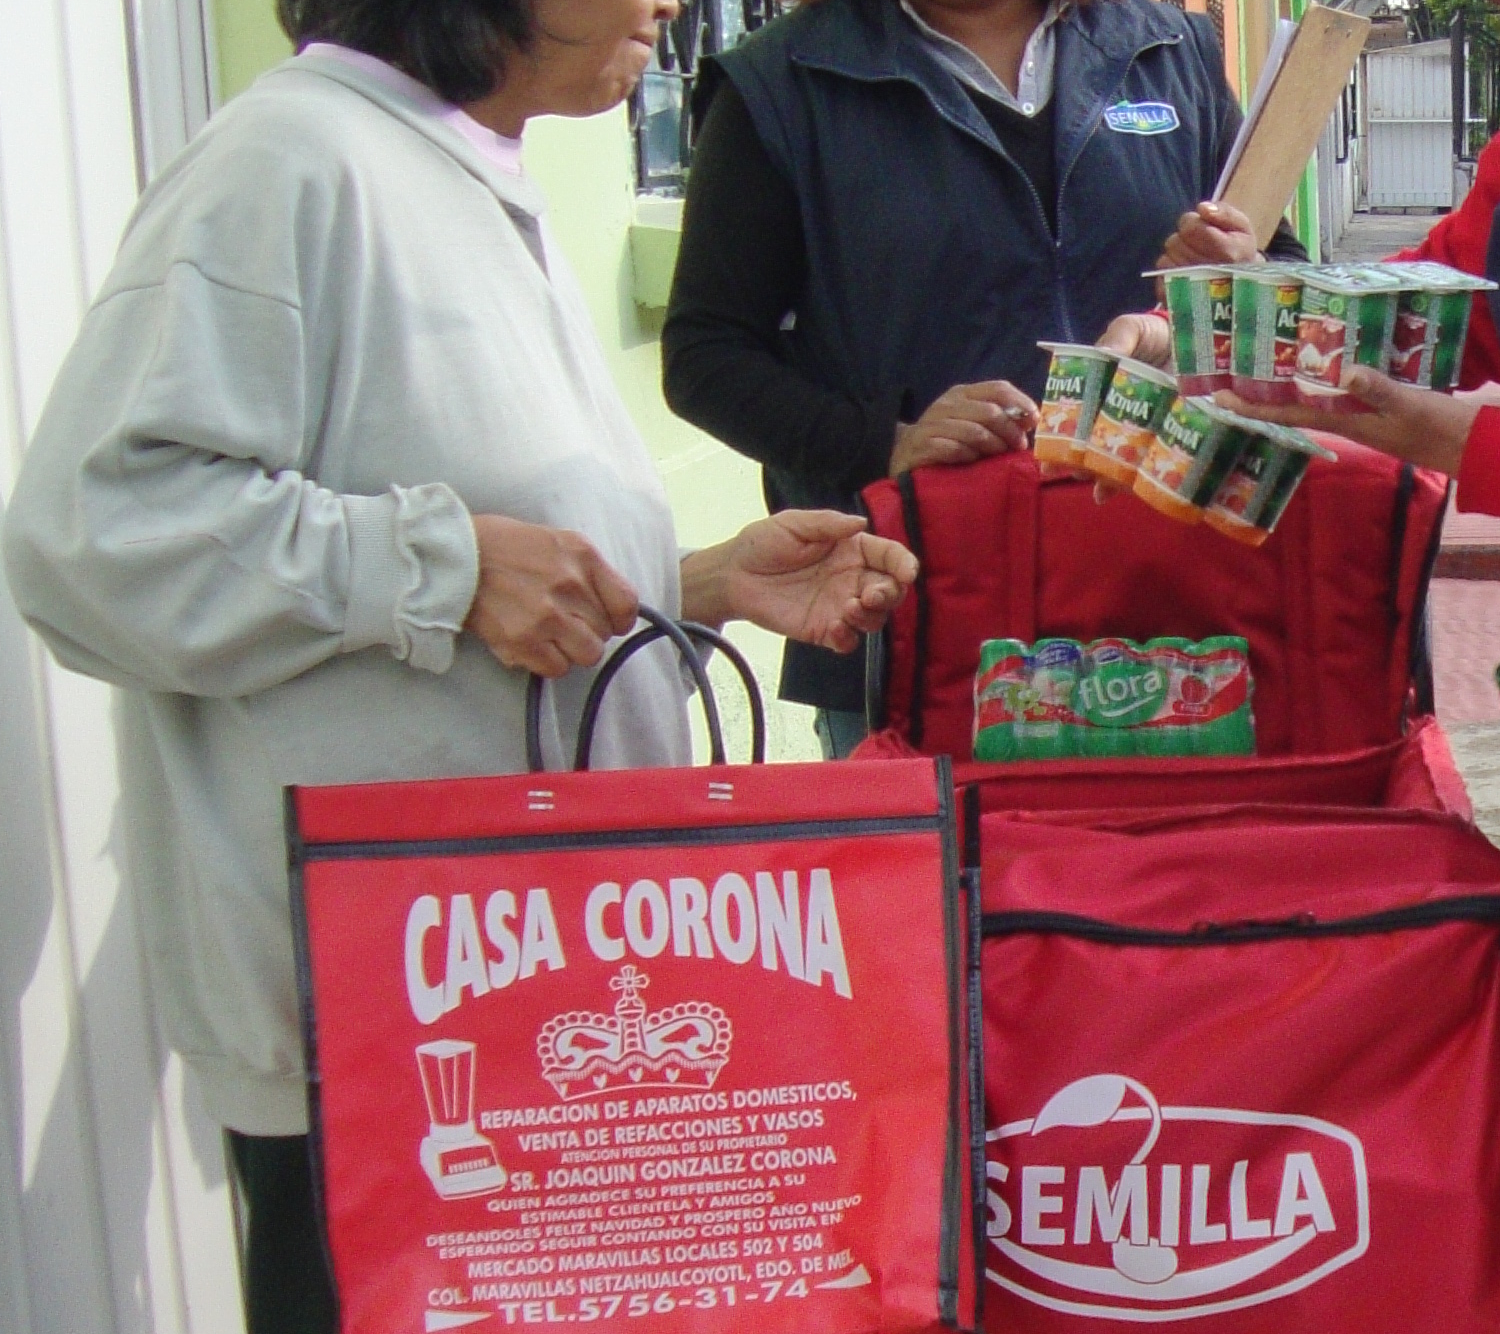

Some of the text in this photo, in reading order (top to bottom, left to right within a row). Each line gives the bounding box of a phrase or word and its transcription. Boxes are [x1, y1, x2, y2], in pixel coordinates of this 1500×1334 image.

[1108, 109, 1172, 125] SEMILLA
[1078, 670, 1162, 710] flora
[404, 868, 853, 1025] CASA CORONA
[480, 1081, 857, 1130] REPARACION DE APARATOS DOMESTICOS,
[518, 1109, 825, 1152] VENTA DE REFACCIONES Y VASOS
[561, 1133, 788, 1164] ATENCION PERSONAL DE SU PROPIETARIO
[510, 1145, 837, 1192] SR. JOAQUIN GONZALEZ CORONA
[487, 1173, 806, 1212] QUIEN AGRADECE SU PREFERENCIA A SU
[520, 1191, 775, 1224] ESTIMABLE CLIENTELA Y AMIGOS
[985, 1151, 1337, 1246] SEMILLA
[425, 1227, 541, 1247] DESEANDOLES
[546, 1223, 586, 1237] FELIZ
[591, 1216, 665, 1233] NAVIDAD
[669, 1214, 681, 1226] Y
[684, 1207, 765, 1224] PROSPERO
[811, 1194, 862, 1213] NUEVO
[439, 1240, 535, 1260] ESPERANDO
[539, 1235, 598, 1251] SEGUIR
[601, 1226, 696, 1246] CONTANDO
[700, 1223, 739, 1238] CON
[743, 1220, 764, 1233] SU
[768, 1216, 817, 1231] VISITA
[468, 1232, 824, 1279] MERCADO MARAVILLAS LOCALES 502 Y 504
[428, 1287, 469, 1307] COL.
[472, 1277, 576, 1302] MARAVILLAS
[579, 1265, 752, 1294] NETZAHUALCOYOTL,
[755, 1260, 796, 1279] EDO.
[801, 1256, 823, 1274] DE
